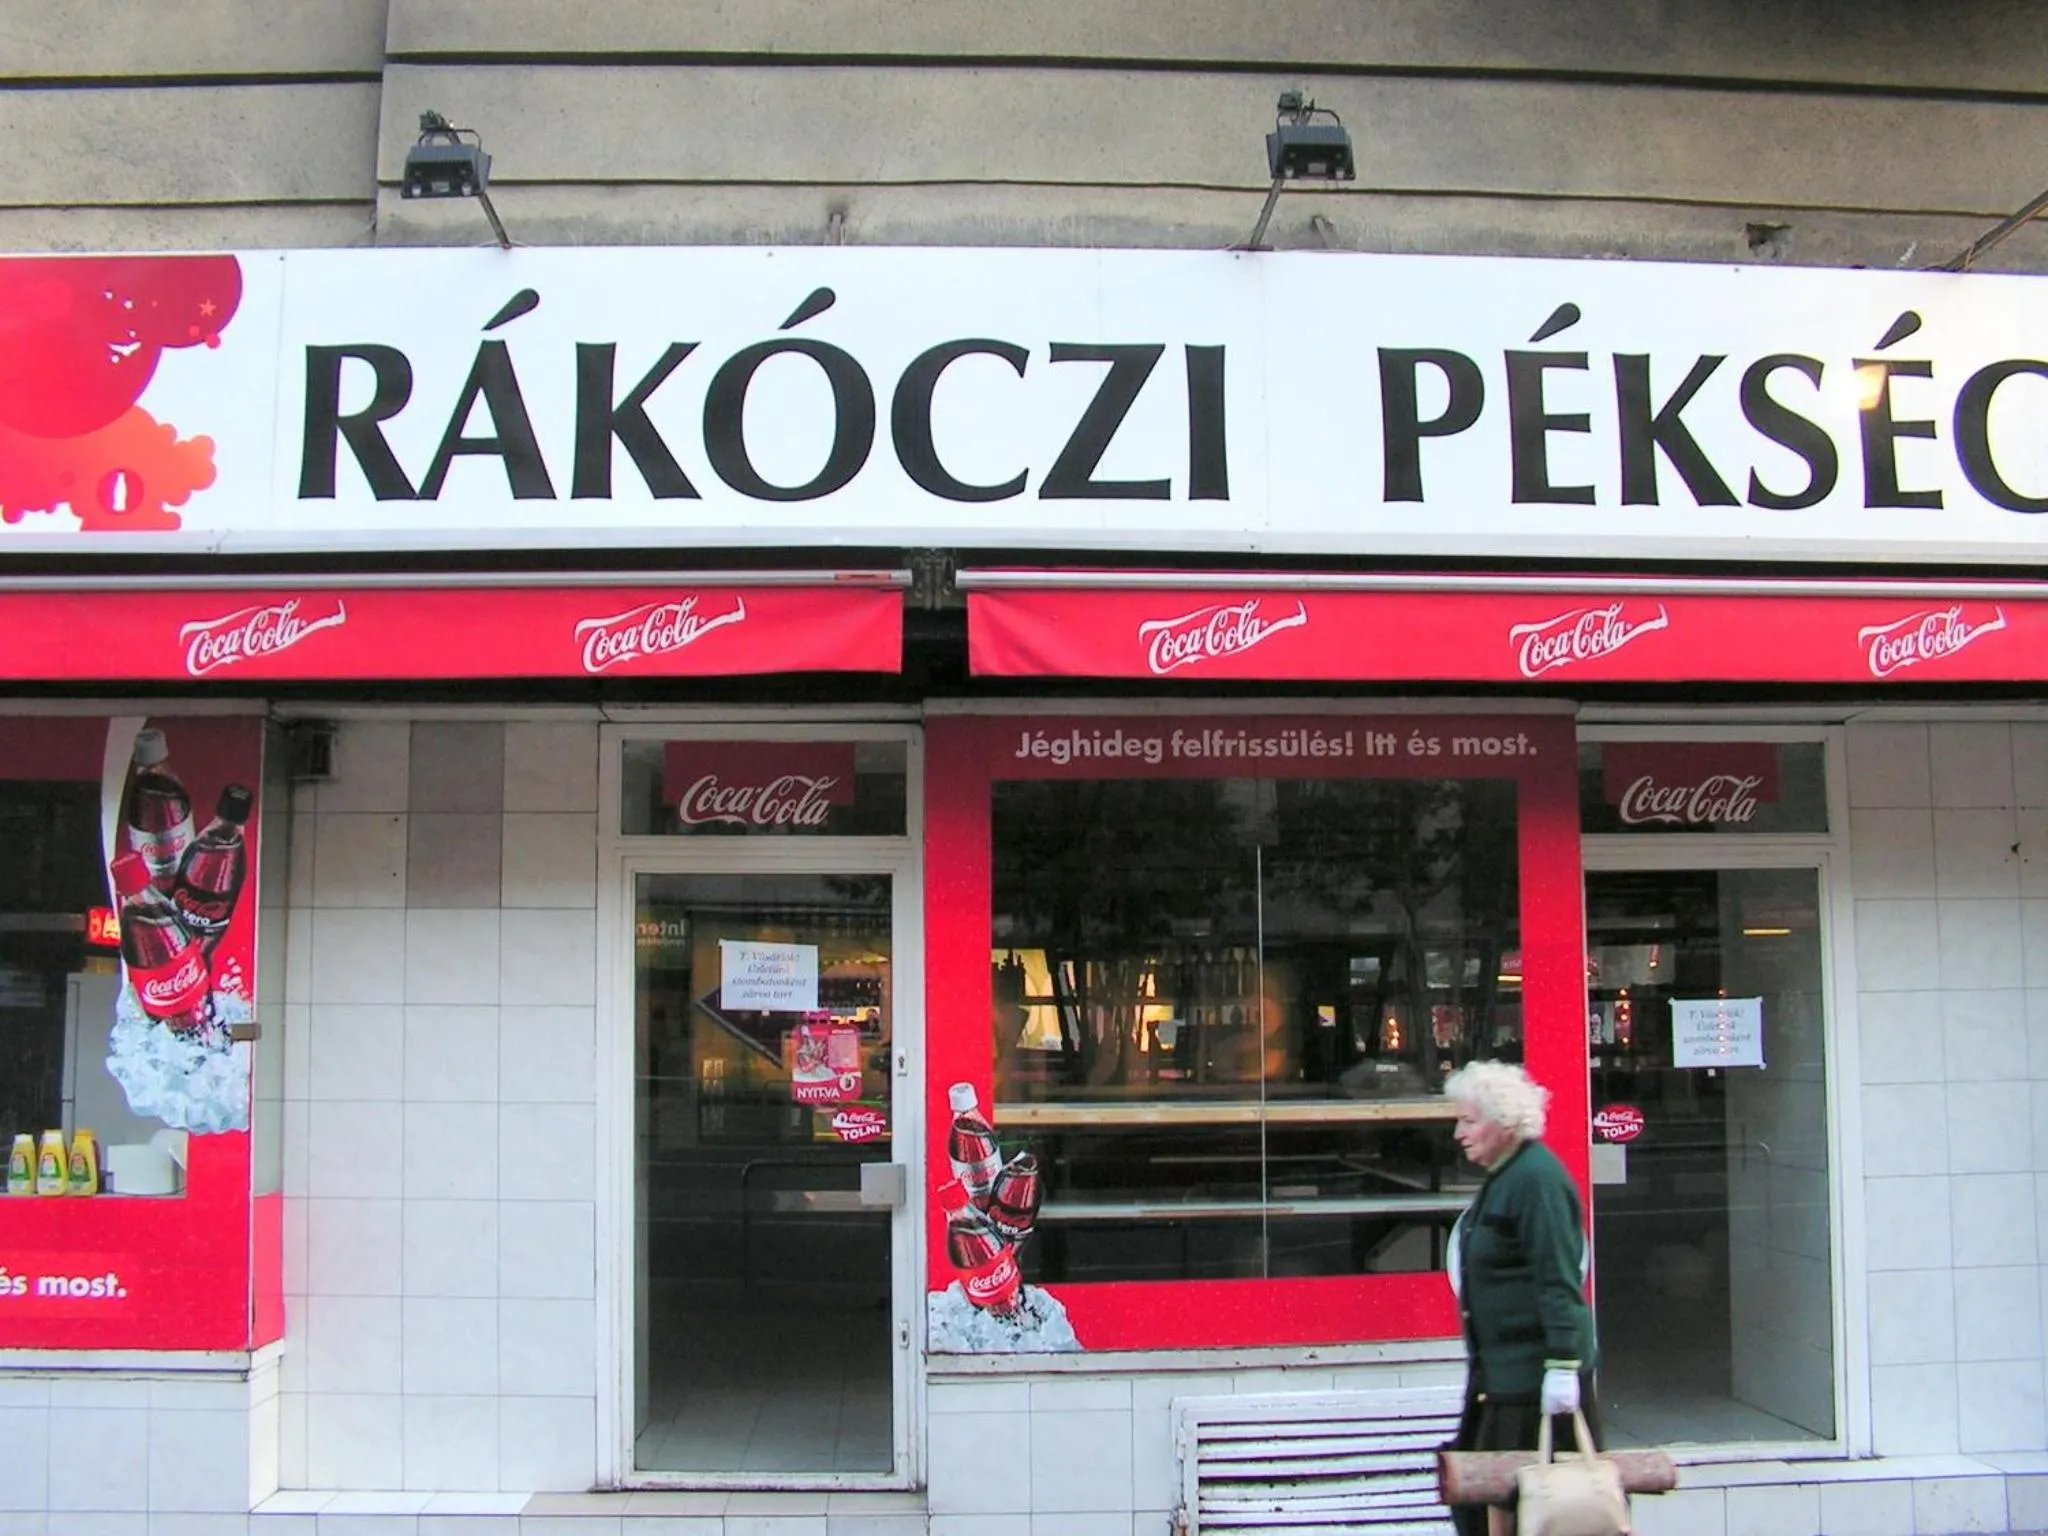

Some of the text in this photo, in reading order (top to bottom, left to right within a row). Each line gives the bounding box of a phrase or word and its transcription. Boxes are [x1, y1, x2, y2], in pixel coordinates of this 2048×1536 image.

[297, 286, 1228, 503] RÁKÓCZI
[179, 597, 346, 676] Coca-Cola
[575, 595, 746, 673] Coca-Cola
[1139, 598, 1308, 674] Coca-Cola
[1509, 600, 1668, 678] Coca-Cola
[1858, 602, 2007, 678] Coca-Cola
[1016, 729, 1537, 764] Jéghideg felfrissülés! Itt és most.
[680, 774, 840, 825] Coca-Cola
[1620, 775, 1763, 824] Coca-Cola
[182, 911, 212, 927] zero
[144, 957, 200, 997] Coca-Cola
[797, 1086, 840, 1099] NYITVA
[841, 1124, 881, 1141] TOLNI
[0, 1266, 128, 1298] és most.
